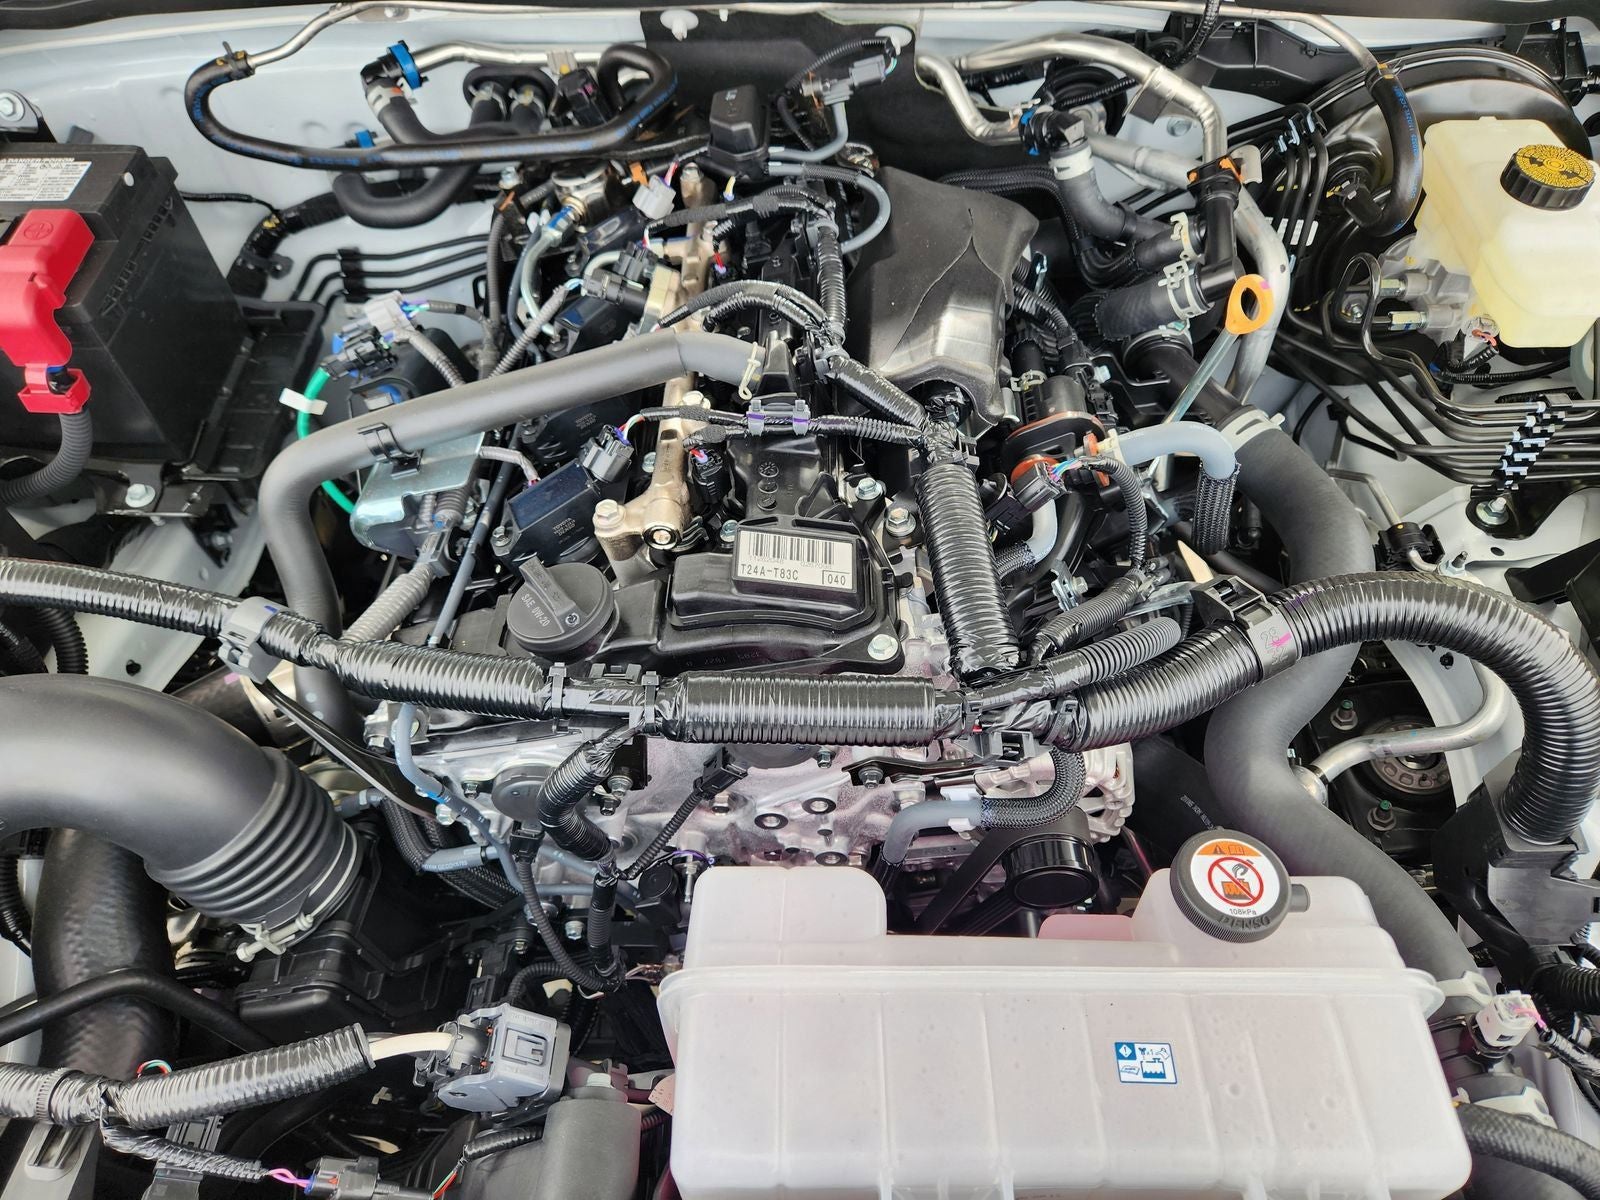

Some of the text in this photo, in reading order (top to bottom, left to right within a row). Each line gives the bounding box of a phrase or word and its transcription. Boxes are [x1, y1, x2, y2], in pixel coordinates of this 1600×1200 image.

[740, 563, 846, 586] T24A-T83C 040
[521, 593, 536, 608] SAE
[531, 605, 551, 627] 0W-20
[1229, 908, 1257, 916] 108kPa
[1218, 915, 1271, 929] DENSO
